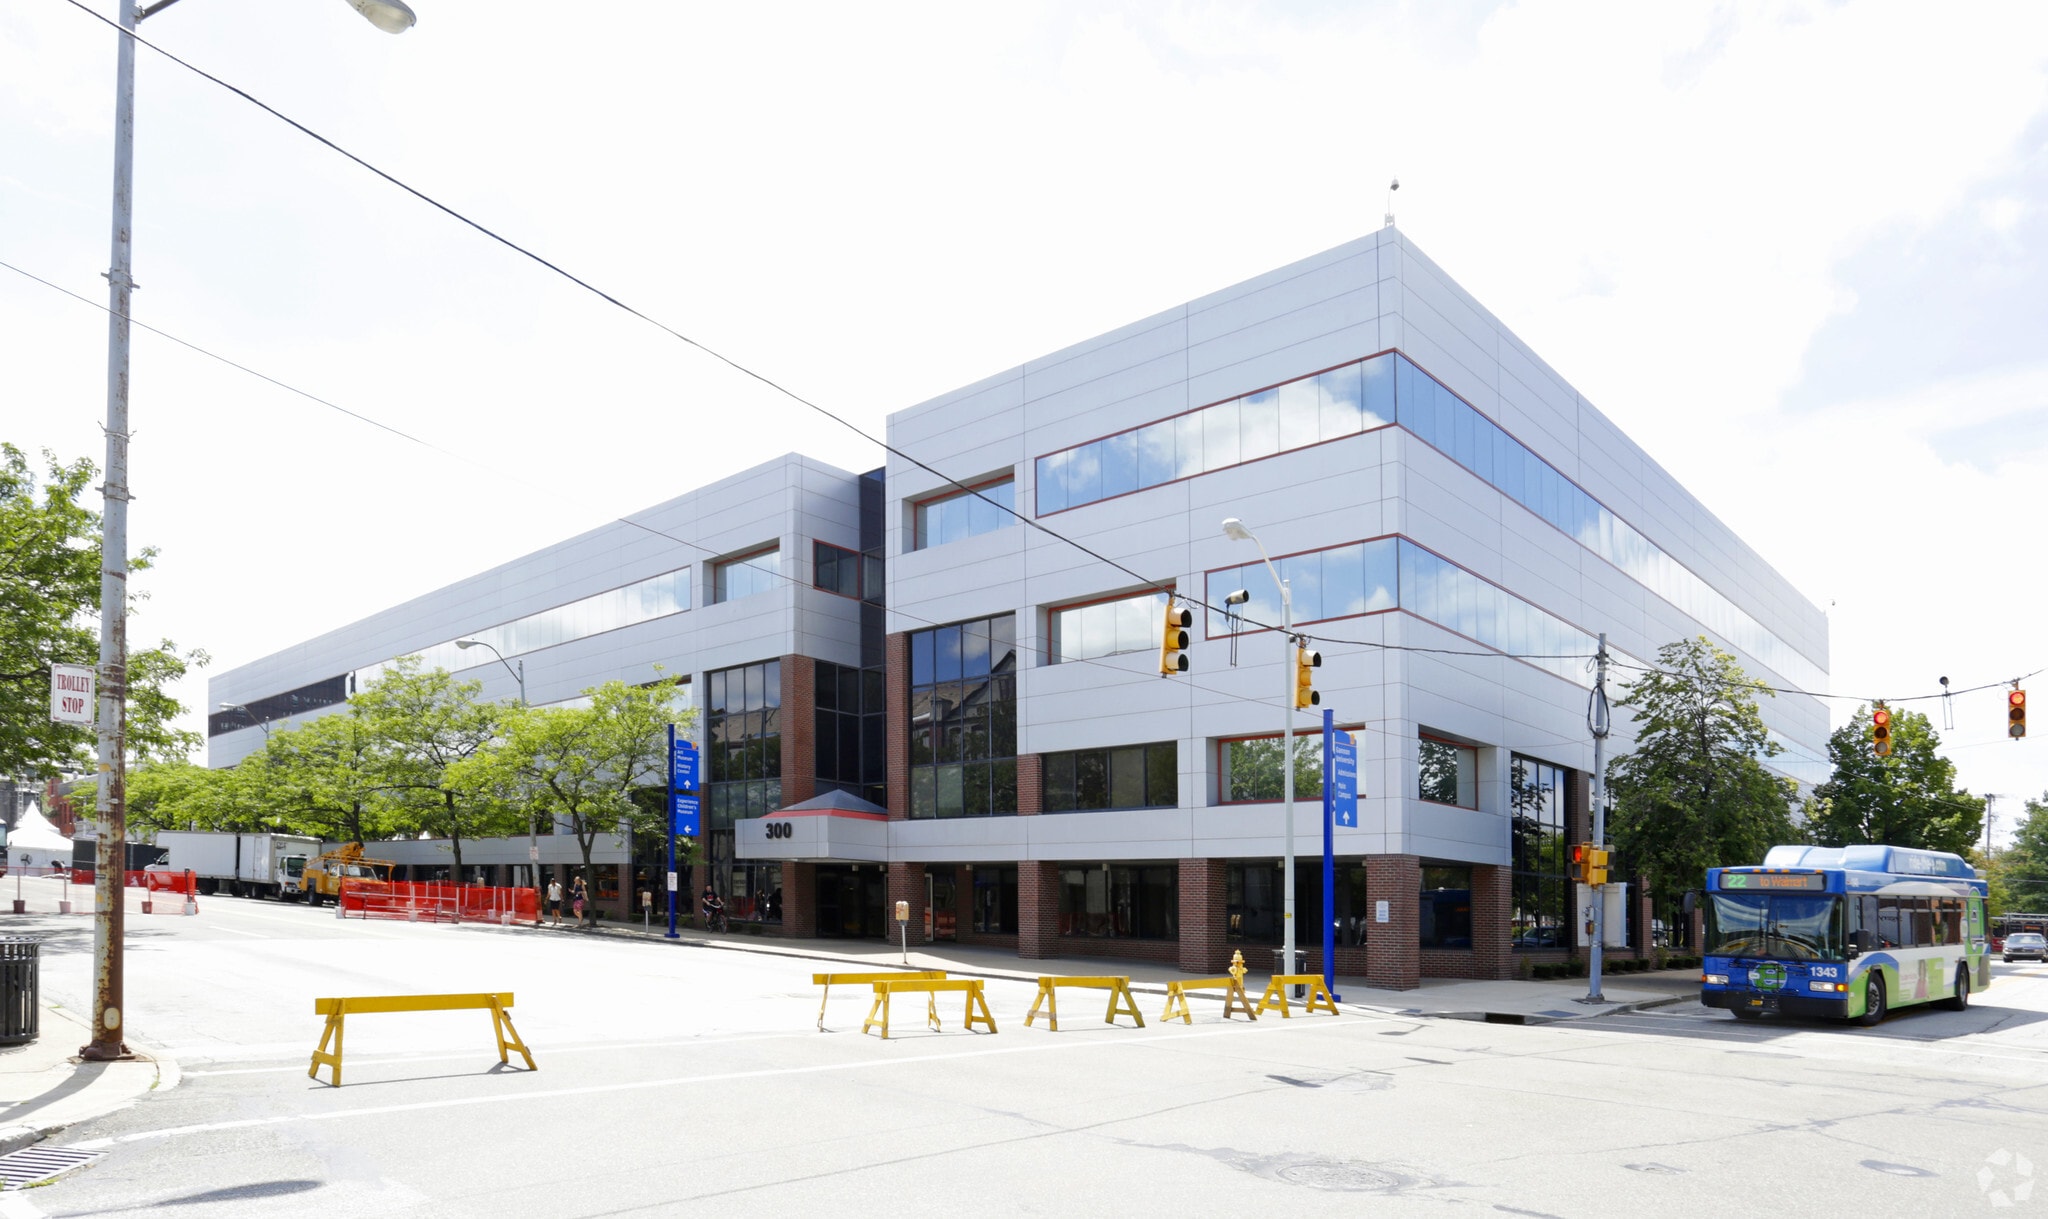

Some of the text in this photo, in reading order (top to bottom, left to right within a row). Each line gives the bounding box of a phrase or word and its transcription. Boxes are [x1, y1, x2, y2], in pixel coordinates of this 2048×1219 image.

[57, 674, 90, 693] TROLLEY
[62, 697, 84, 714] STOP
[1336, 755, 1355, 766] University
[1338, 791, 1351, 800] Campus
[765, 822, 792, 839] 300
[1727, 875, 1808, 888] 22 to Walmart
[1809, 966, 1837, 978] 1343
